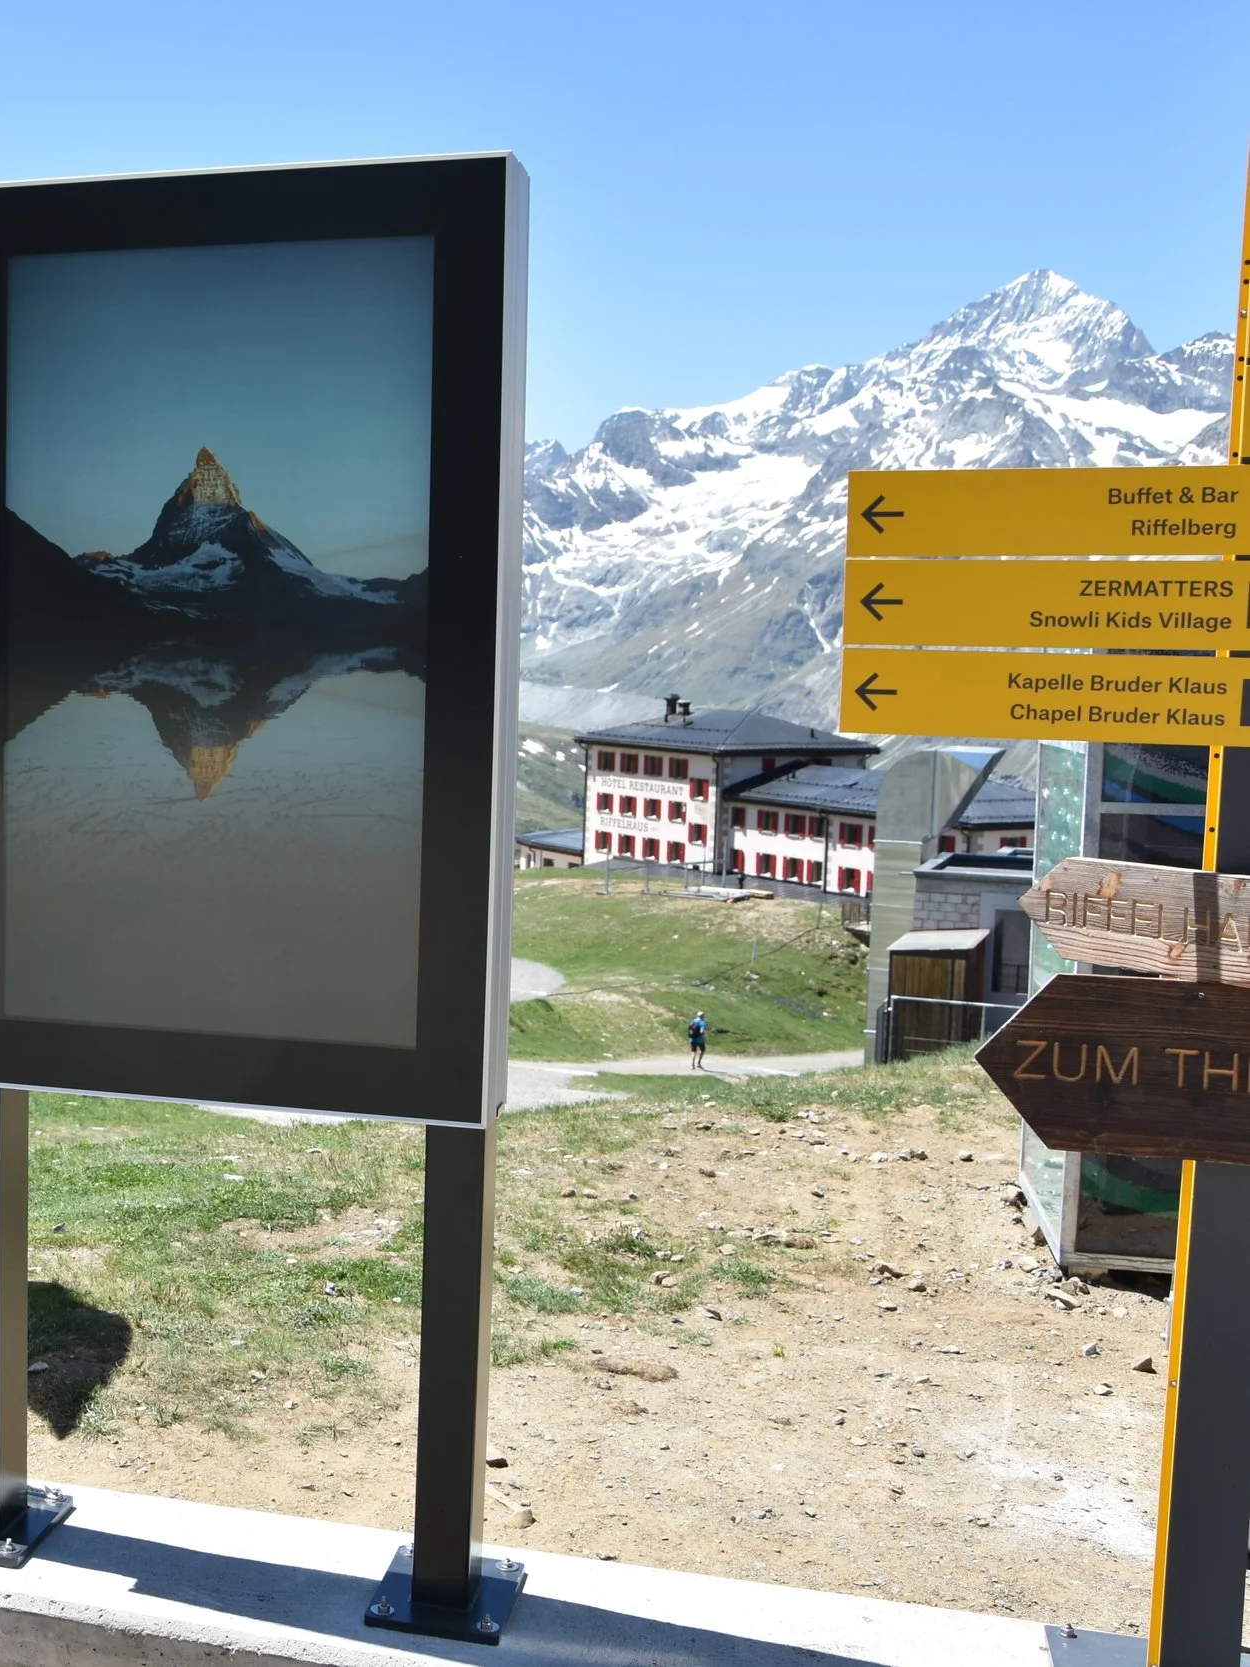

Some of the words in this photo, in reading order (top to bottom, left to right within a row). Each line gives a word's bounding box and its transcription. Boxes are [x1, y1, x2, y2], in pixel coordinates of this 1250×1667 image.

[1108, 487, 1173, 505] Buffet
[1179, 486, 1195, 504] &
[1201, 486, 1239, 504] Bar
[1131, 518, 1237, 540] Riffelberg
[1079, 579, 1234, 598] ZERMATTERS
[1029, 610, 1100, 629] Snowli
[1105, 611, 1152, 630] Kids
[1158, 612, 1232, 633] Village
[1007, 672, 1085, 692] Kapelle
[1090, 675, 1162, 695] Bruder
[1168, 677, 1228, 696] Klaus
[1009, 703, 1083, 723] Chapel
[1088, 706, 1161, 725] Bruder
[1166, 708, 1226, 727] Klaus
[601, 777, 627, 790] HOTEL
[629, 781, 684, 797] RESTAURANT
[600, 816, 650, 833] RIFFELHAUS
[1045, 888, 1250, 954] RIFFELHA
[1013, 1040, 1139, 1086] ZUM
[1164, 1047, 1250, 1094] TH
